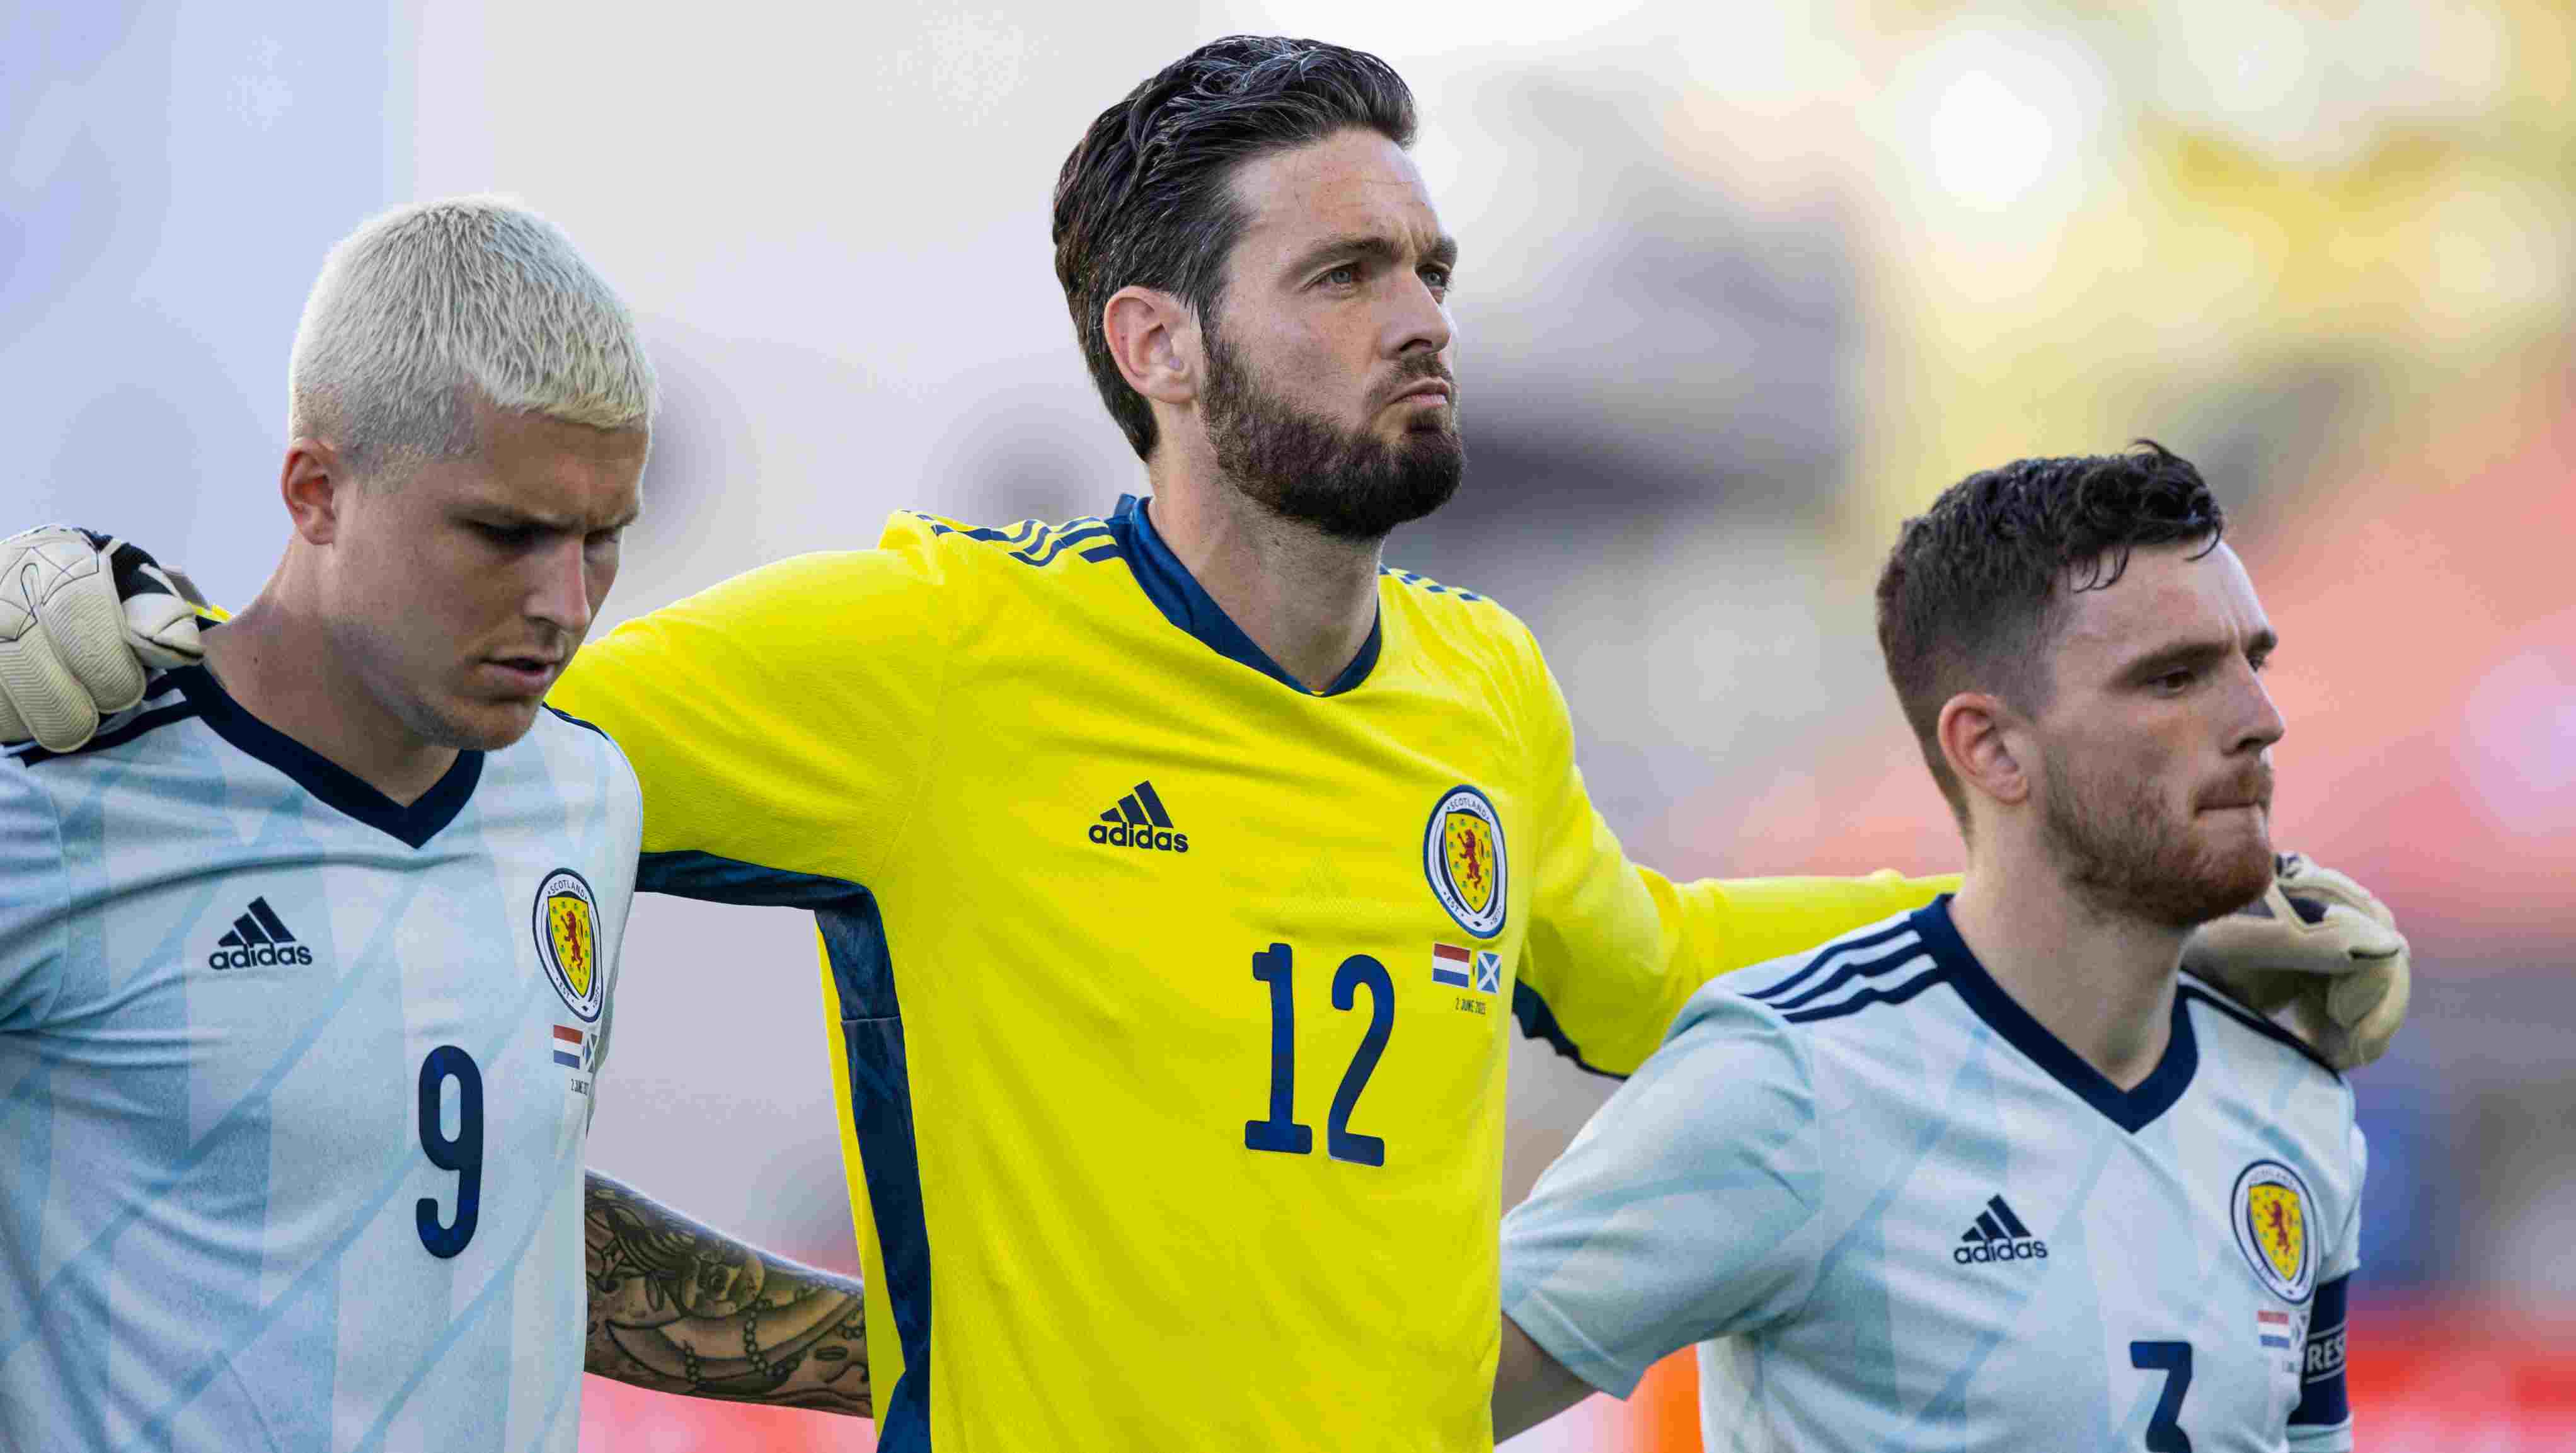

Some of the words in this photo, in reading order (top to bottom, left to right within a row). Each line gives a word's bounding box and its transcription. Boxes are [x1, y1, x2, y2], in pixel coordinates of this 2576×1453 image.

[1451, 797, 1486, 817] SCOTLAND
[1089, 822, 1189, 853] adidas
[550, 880, 585, 897] SCOTLAND
[209, 944, 313, 970] adidas
[1245, 943, 1394, 1167] 12
[416, 1045, 483, 1259] 9
[1954, 1239, 2048, 1264] adidas
